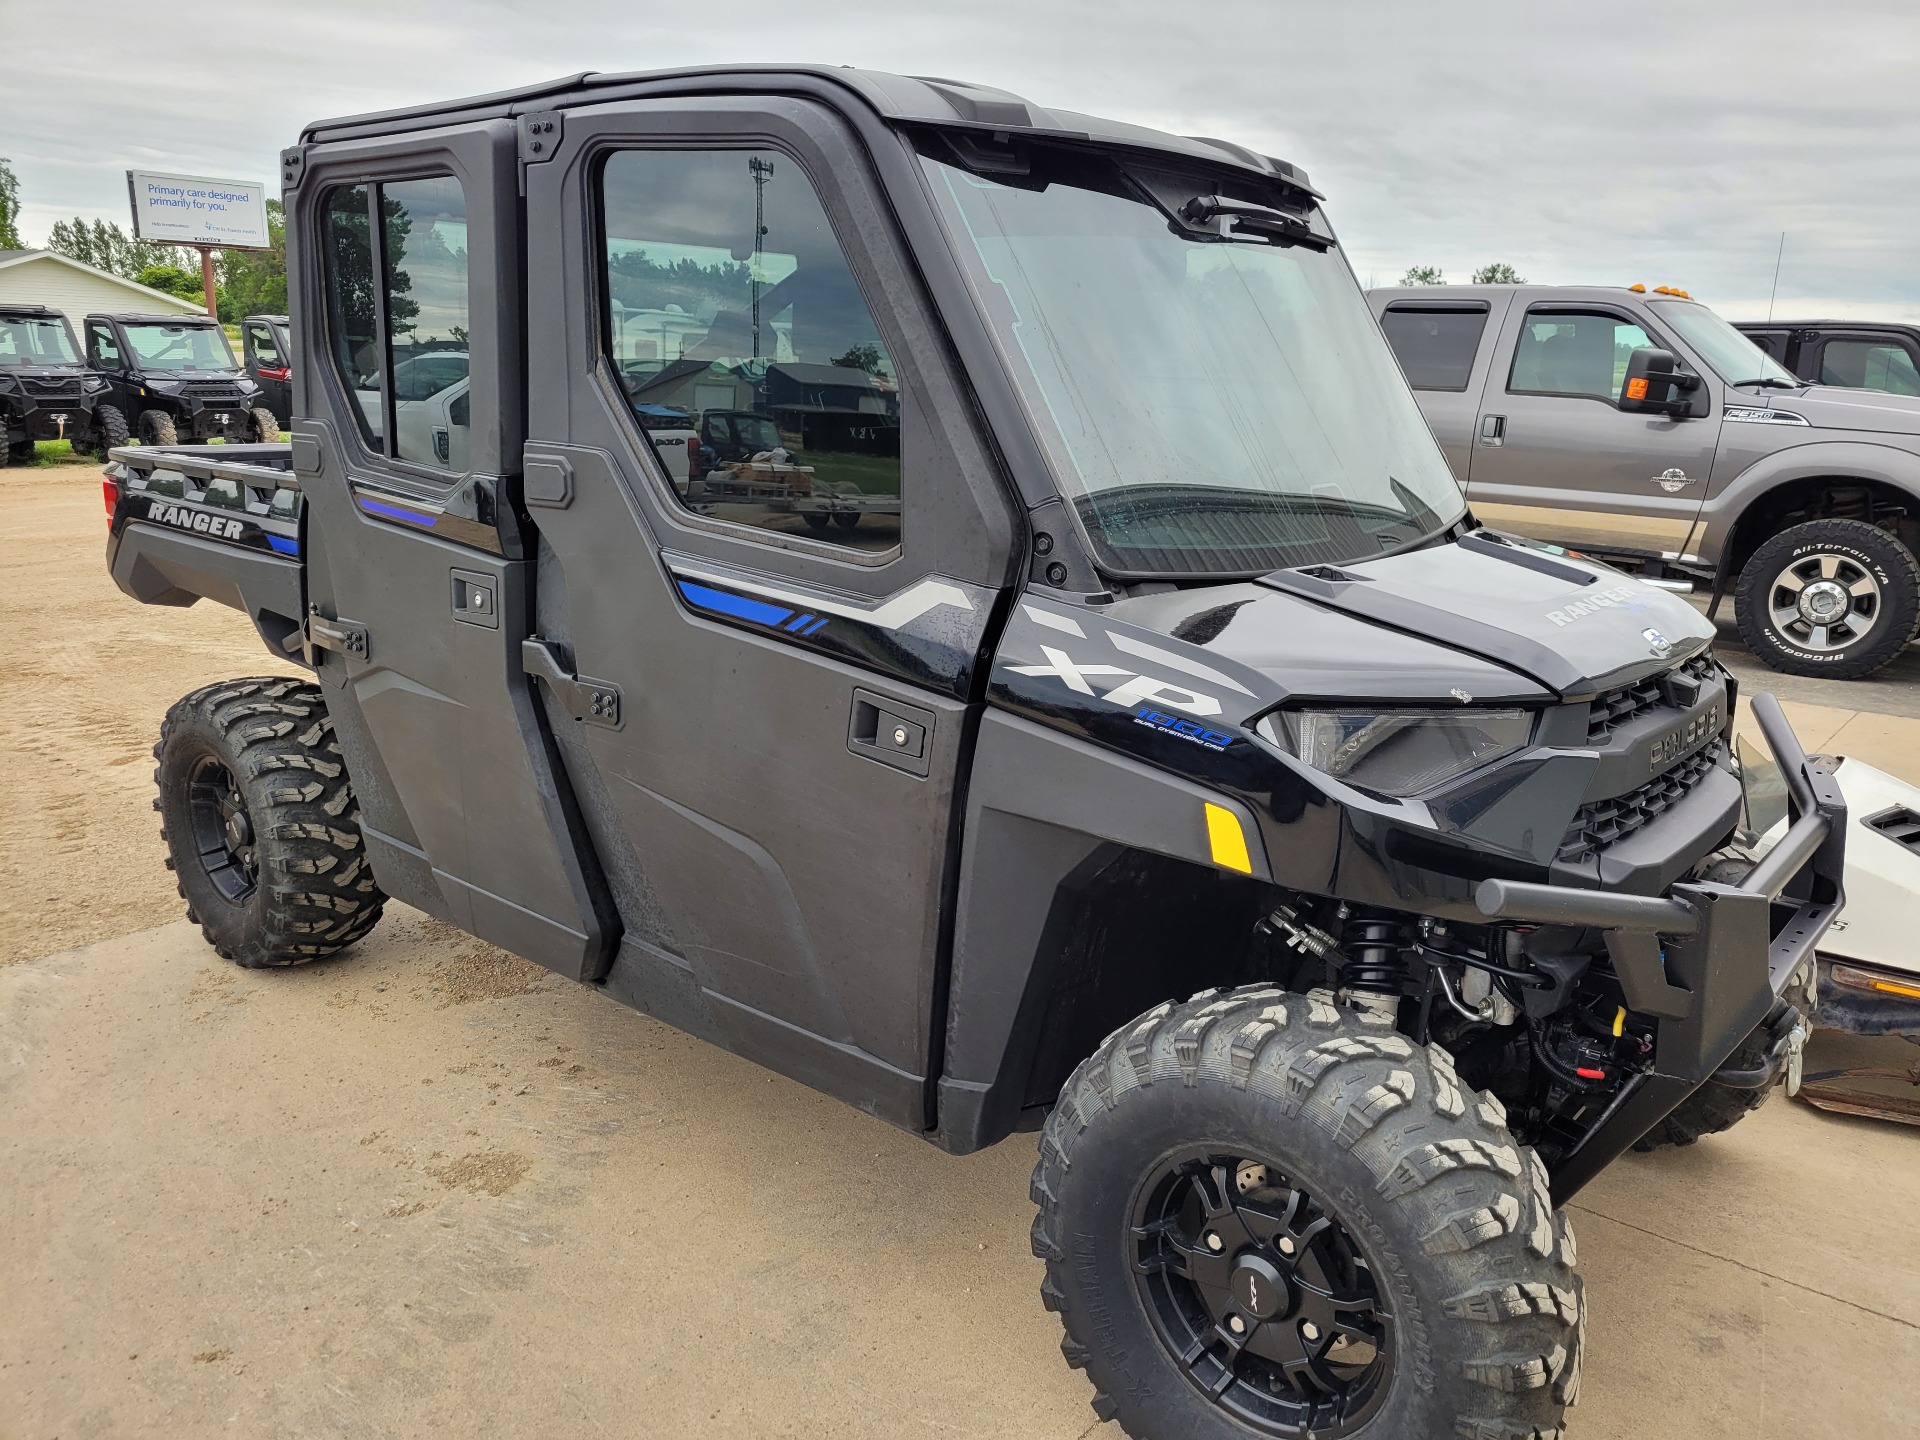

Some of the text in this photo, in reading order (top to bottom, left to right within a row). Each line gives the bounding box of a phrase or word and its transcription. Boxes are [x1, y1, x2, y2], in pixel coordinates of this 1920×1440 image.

[148, 184, 249, 202] Primary care designed
[150, 198, 227, 211] primarily for you.
[147, 502, 244, 540] RANGER
[1792, 543, 1889, 585] All-Terrain T/A
[1543, 586, 1638, 627] RANGER
[1764, 628, 1844, 662] BFGoodrich
[1002, 644, 1223, 716] XP
[1133, 718, 1156, 729] DUAL
[1203, 741, 1225, 752] CAM
[1136, 707, 1234, 747] 1000
[1650, 704, 1718, 772] POLARIS
[1073, 1232, 1154, 1407] X-TERRAIN
